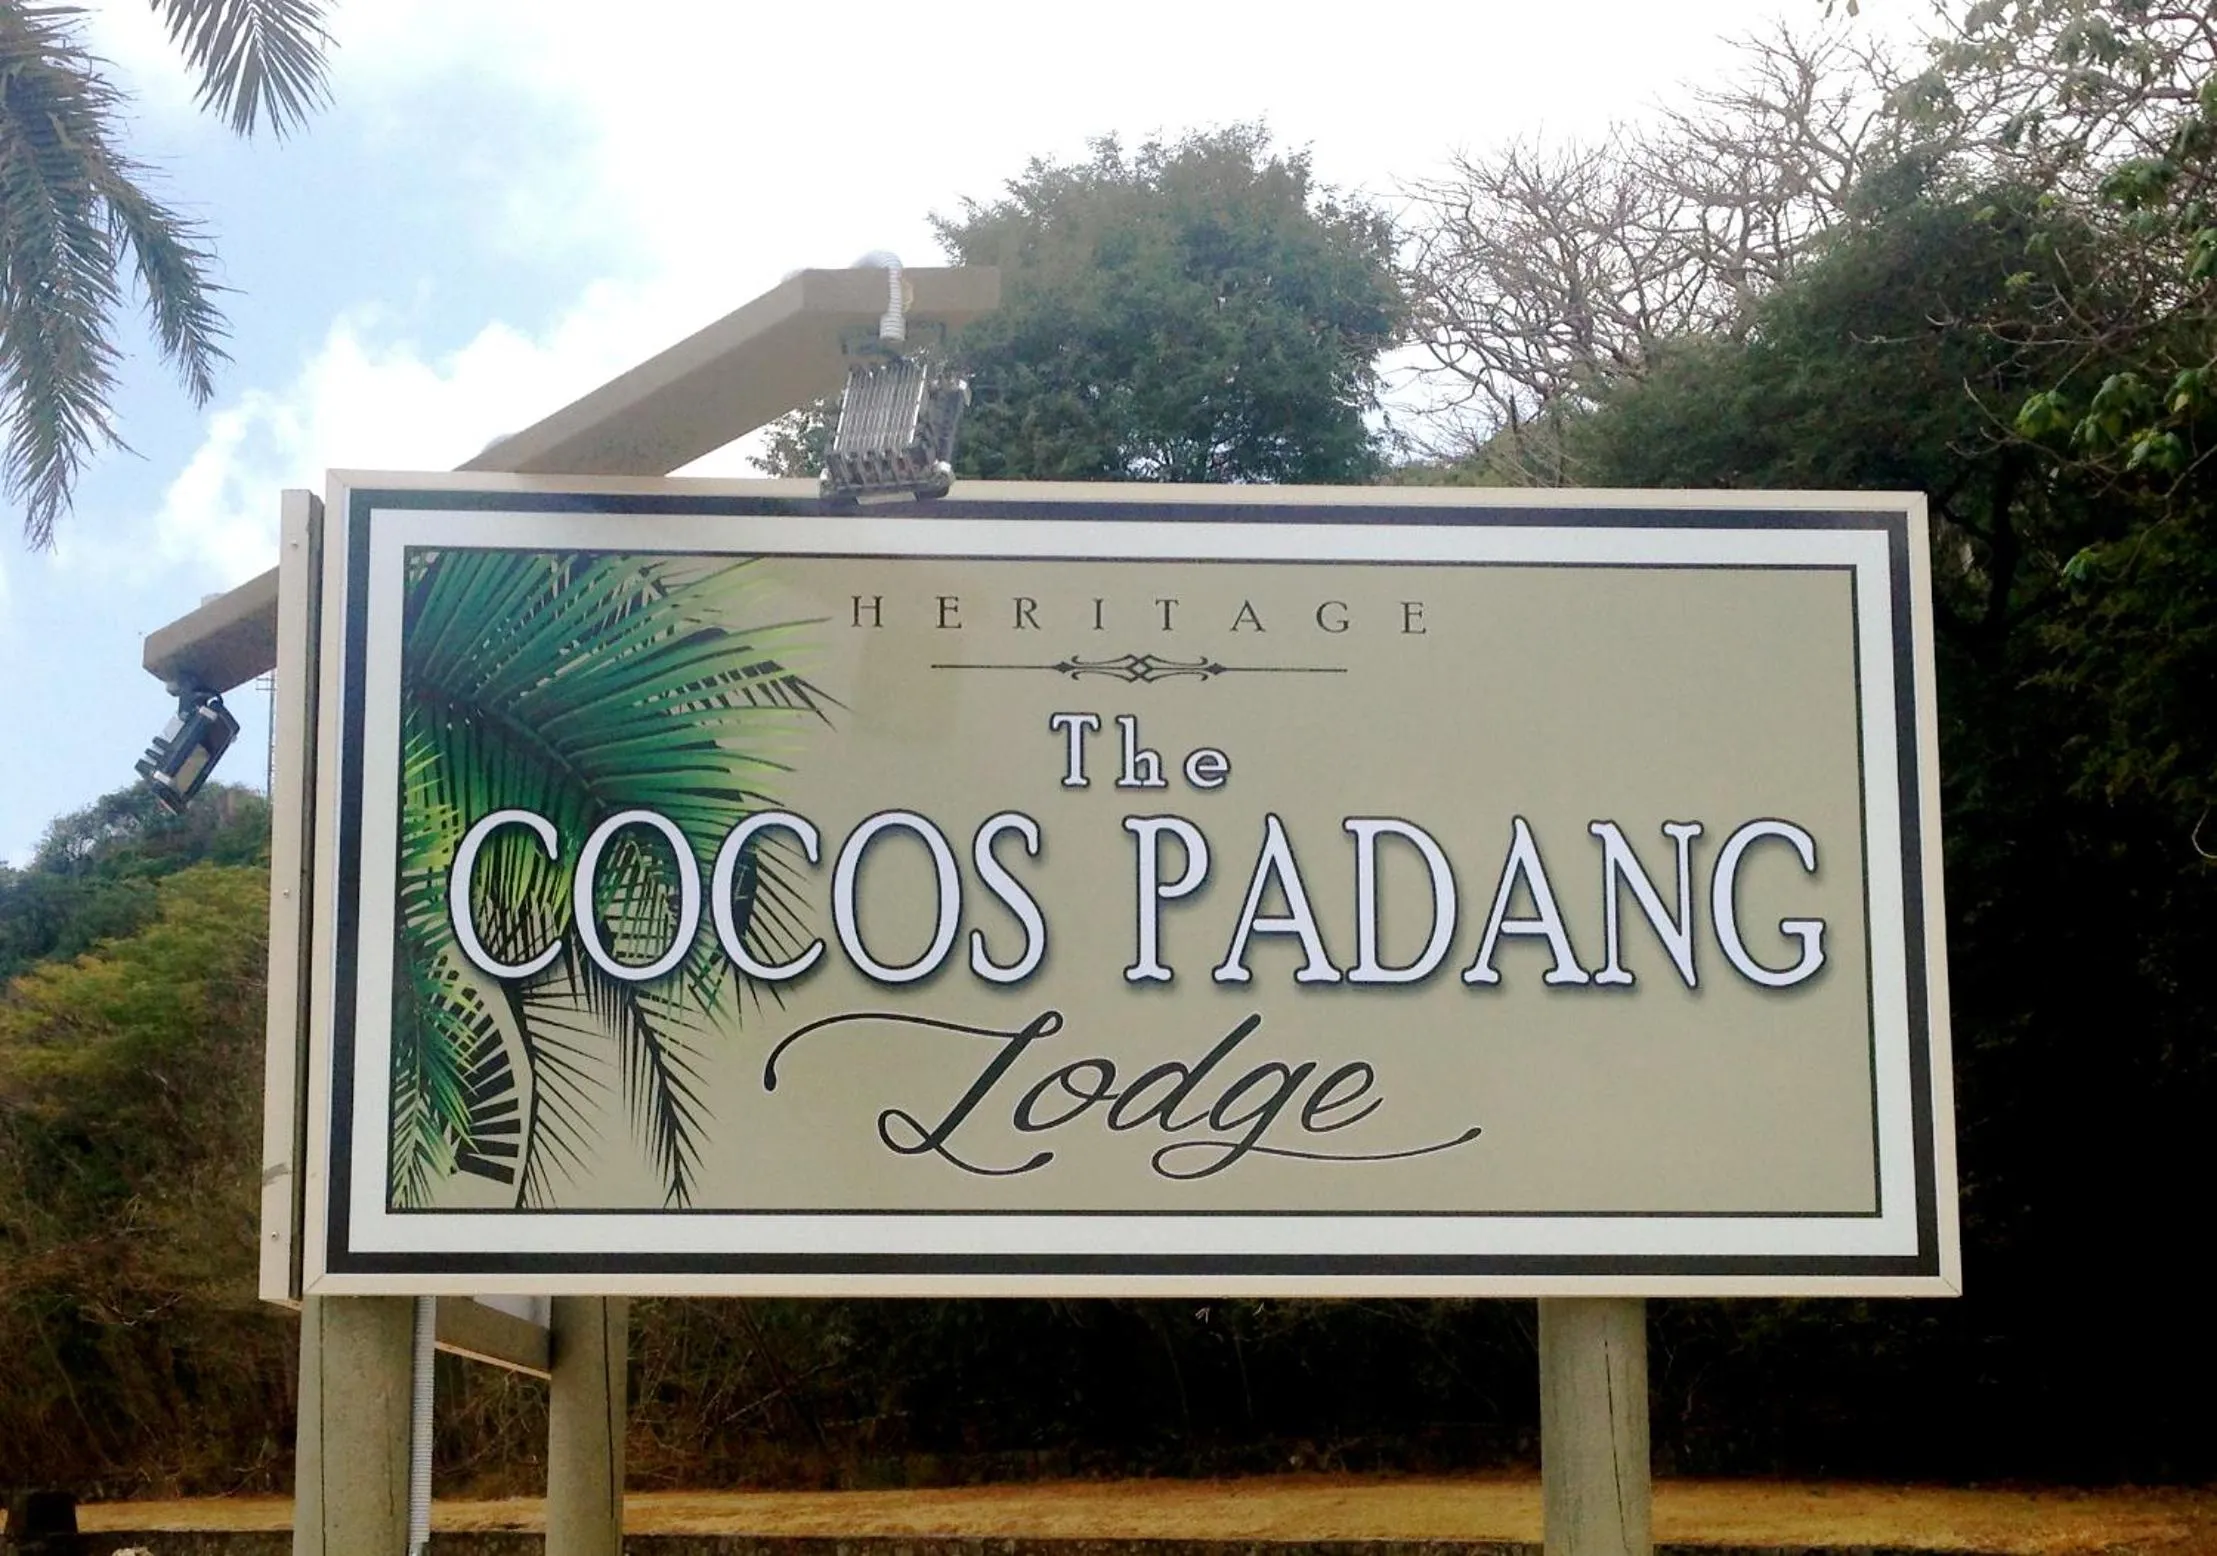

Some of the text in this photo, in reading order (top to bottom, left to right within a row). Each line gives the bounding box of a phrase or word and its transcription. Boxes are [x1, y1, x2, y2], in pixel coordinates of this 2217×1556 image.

[850, 594, 1428, 635] HERITAGE
[1049, 711, 1231, 789] The
[447, 808, 1828, 990] COCOS PADANG
[763, 1010, 1482, 1180] Lodge
